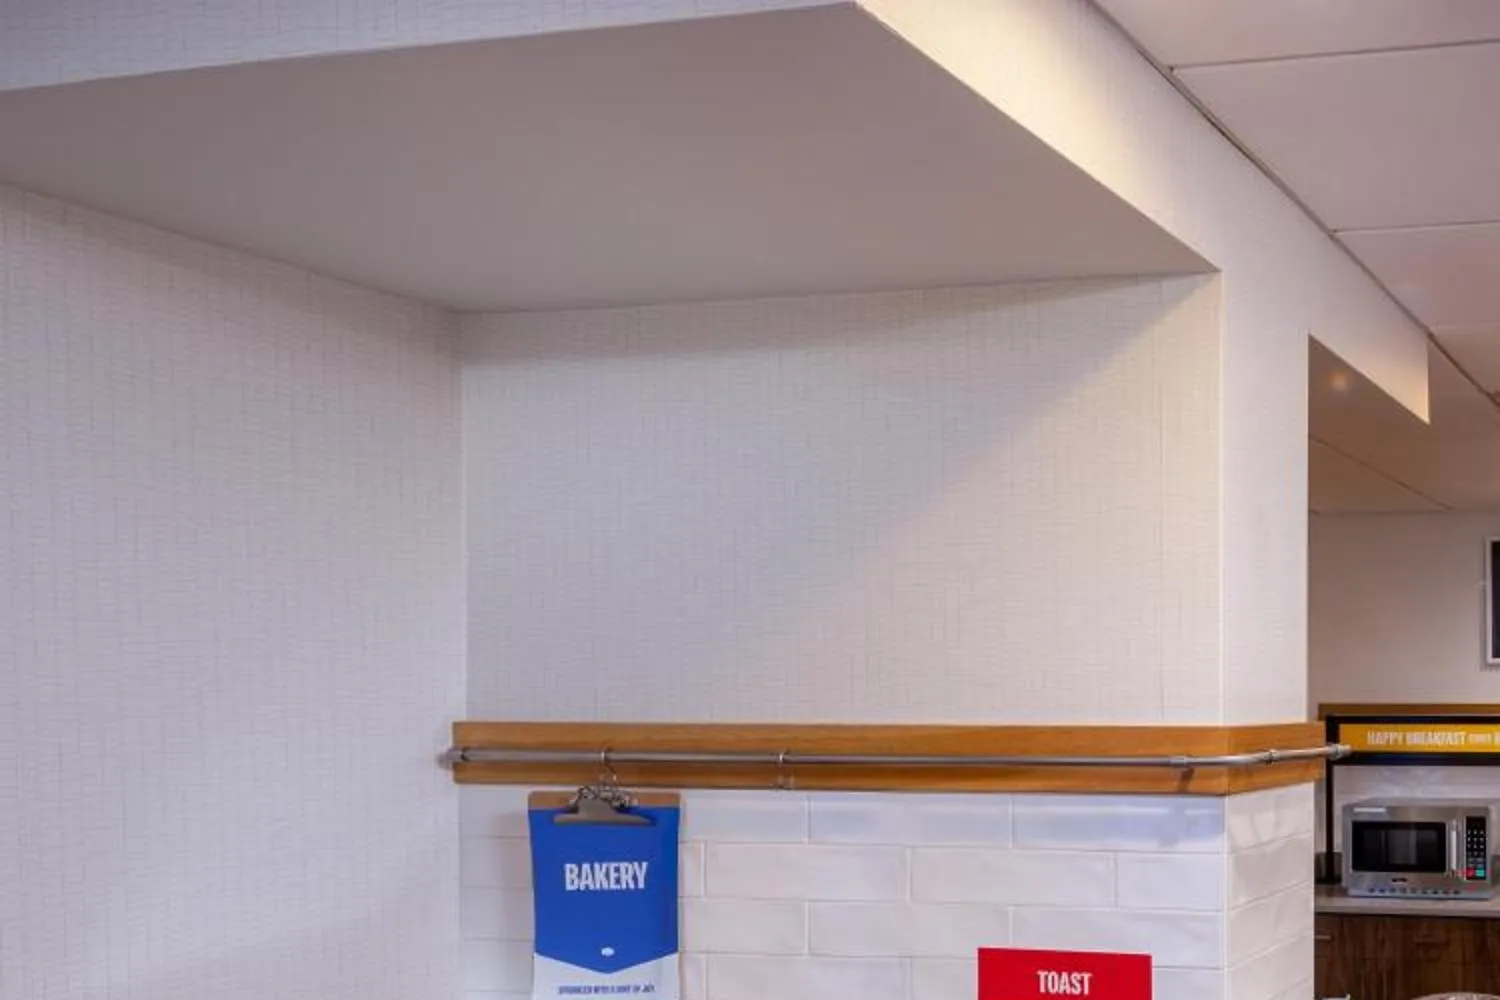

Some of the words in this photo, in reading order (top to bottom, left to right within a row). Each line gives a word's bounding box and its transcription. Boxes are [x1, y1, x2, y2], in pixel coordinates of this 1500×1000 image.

[1367, 731, 1403, 745] HAPPY
[1405, 731, 1467, 745] BREAKFAST
[565, 861, 648, 891] BAKERY
[1036, 970, 1093, 995] TOAST
